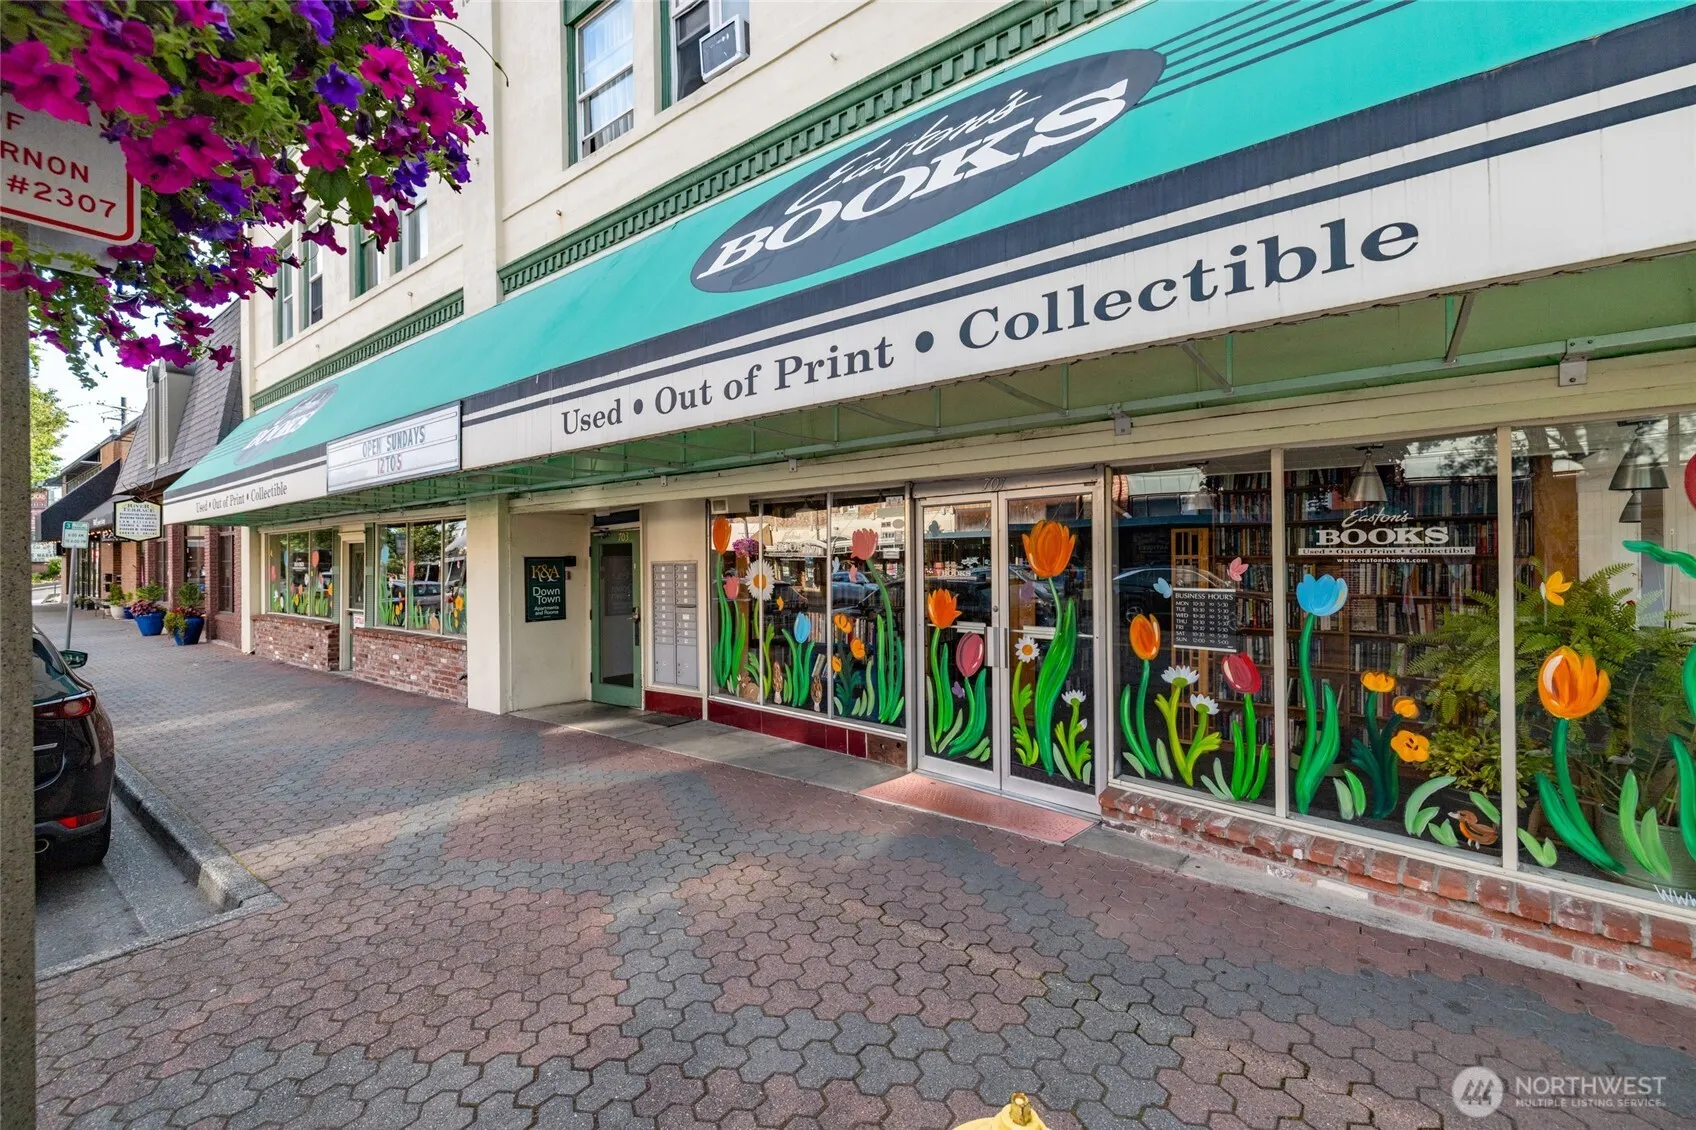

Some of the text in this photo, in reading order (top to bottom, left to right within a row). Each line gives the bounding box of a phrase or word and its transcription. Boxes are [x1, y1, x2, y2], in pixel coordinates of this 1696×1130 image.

[7, 111, 25, 130] F
[0, 140, 89, 183] RNON
[784, 88, 1041, 216] Easton's
[696, 78, 1128, 279] BOOKS
[7, 174, 117, 218] #2307
[561, 217, 1419, 435] Used Out of Print Collectible
[362, 425, 425, 458] OPEN SUNDAYS
[195, 481, 288, 513] Used Out of Print Collectible
[1341, 506, 1414, 529] Easton's
[1316, 526, 1449, 546] BOOKS
[1409, 547, 1471, 555] Collectible
[532, 586, 561, 597] Down
[536, 595, 561, 605] Town
